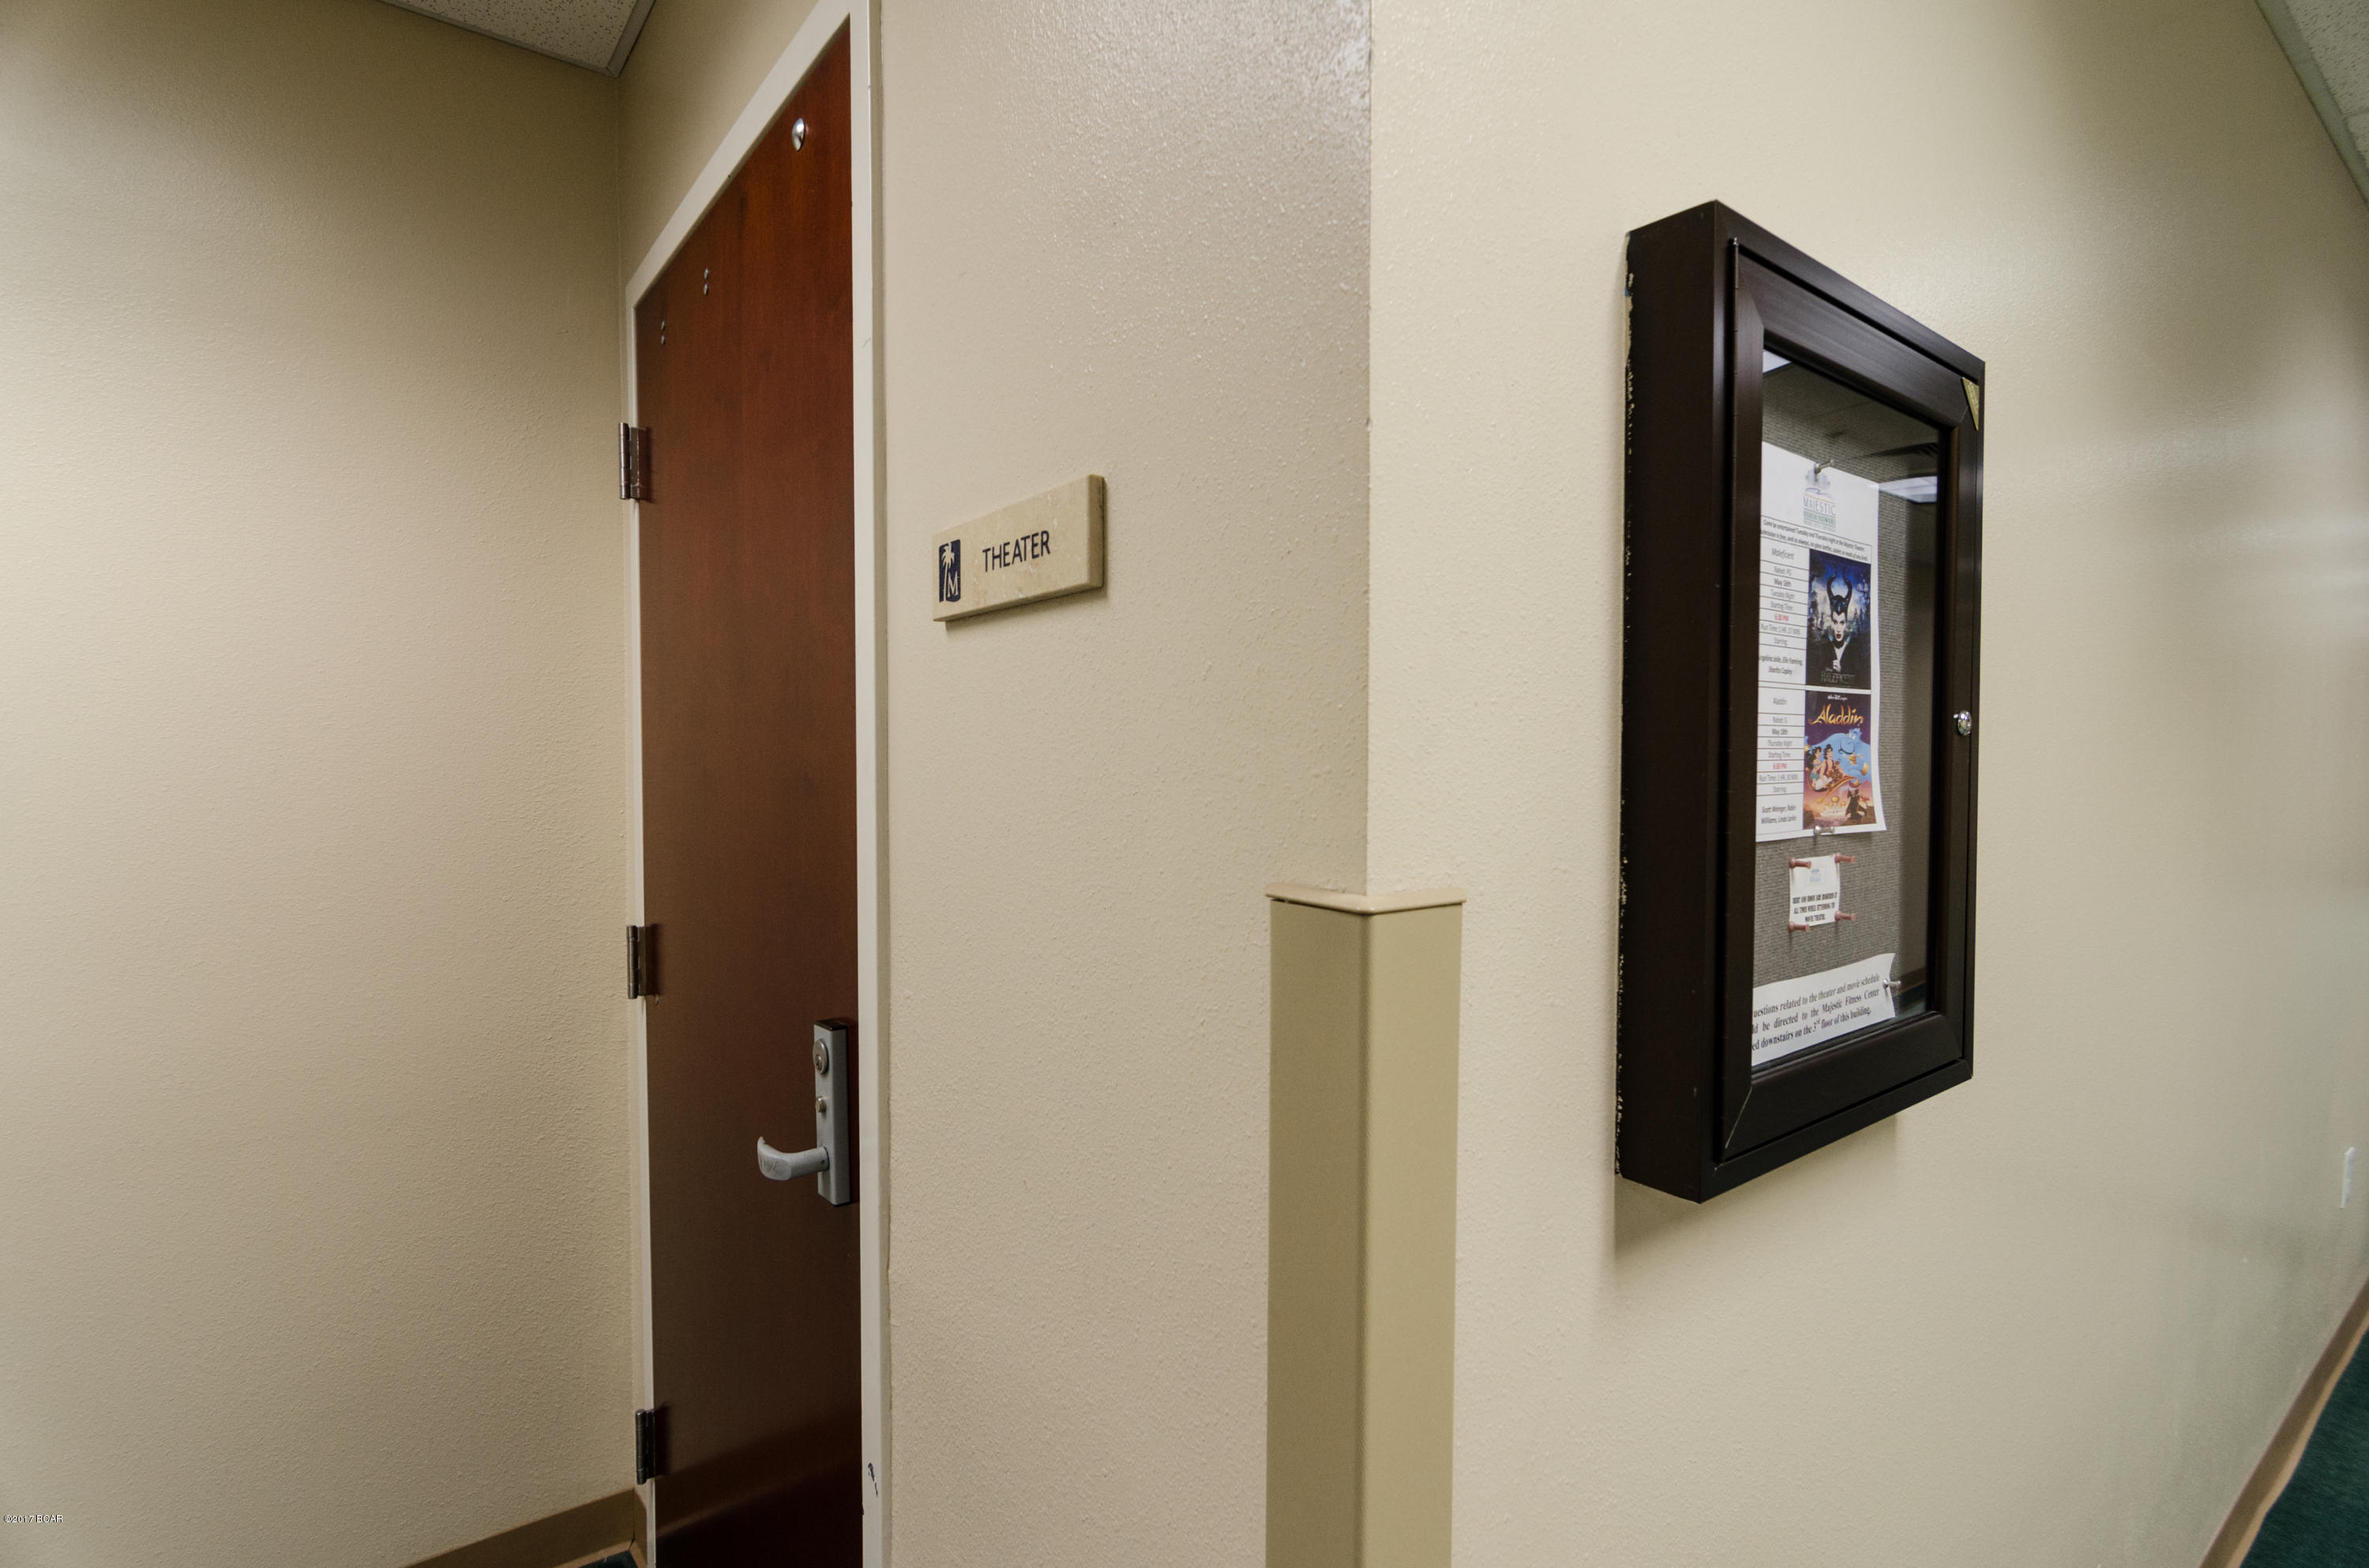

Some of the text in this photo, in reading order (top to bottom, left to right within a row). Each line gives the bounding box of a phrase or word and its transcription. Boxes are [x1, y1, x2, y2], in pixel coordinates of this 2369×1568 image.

[982, 531, 1051, 572] THEATER
[1774, 578, 1782, 587] May
[1808, 702, 1864, 726] Aladdin
[1753, 1003, 1778, 1018] uestions
[1780, 996, 1801, 1011] related
[1819, 989, 1836, 1000] theater
[1837, 983, 1845, 994] and
[1847, 979, 1860, 991] movie
[1861, 973, 1879, 986] schedule
[1763, 1021, 1770, 1031] be
[1774, 1012, 1798, 1028] directed
[1802, 1011, 1808, 1021] to
[1822, 1000, 1842, 1014] Majestic
[1845, 996, 1861, 1006] Fitness
[1864, 988, 1879, 1000] Center
[1761, 1030, 1793, 1048] downstairs
[1795, 1029, 1802, 1037] on
[1804, 1025, 1812, 1035] the
[1821, 1018, 1833, 1030] floor
[1834, 1014, 1840, 1025] of
[1840, 1011, 1849, 1022] this
[1850, 1007, 1871, 1019] building.
